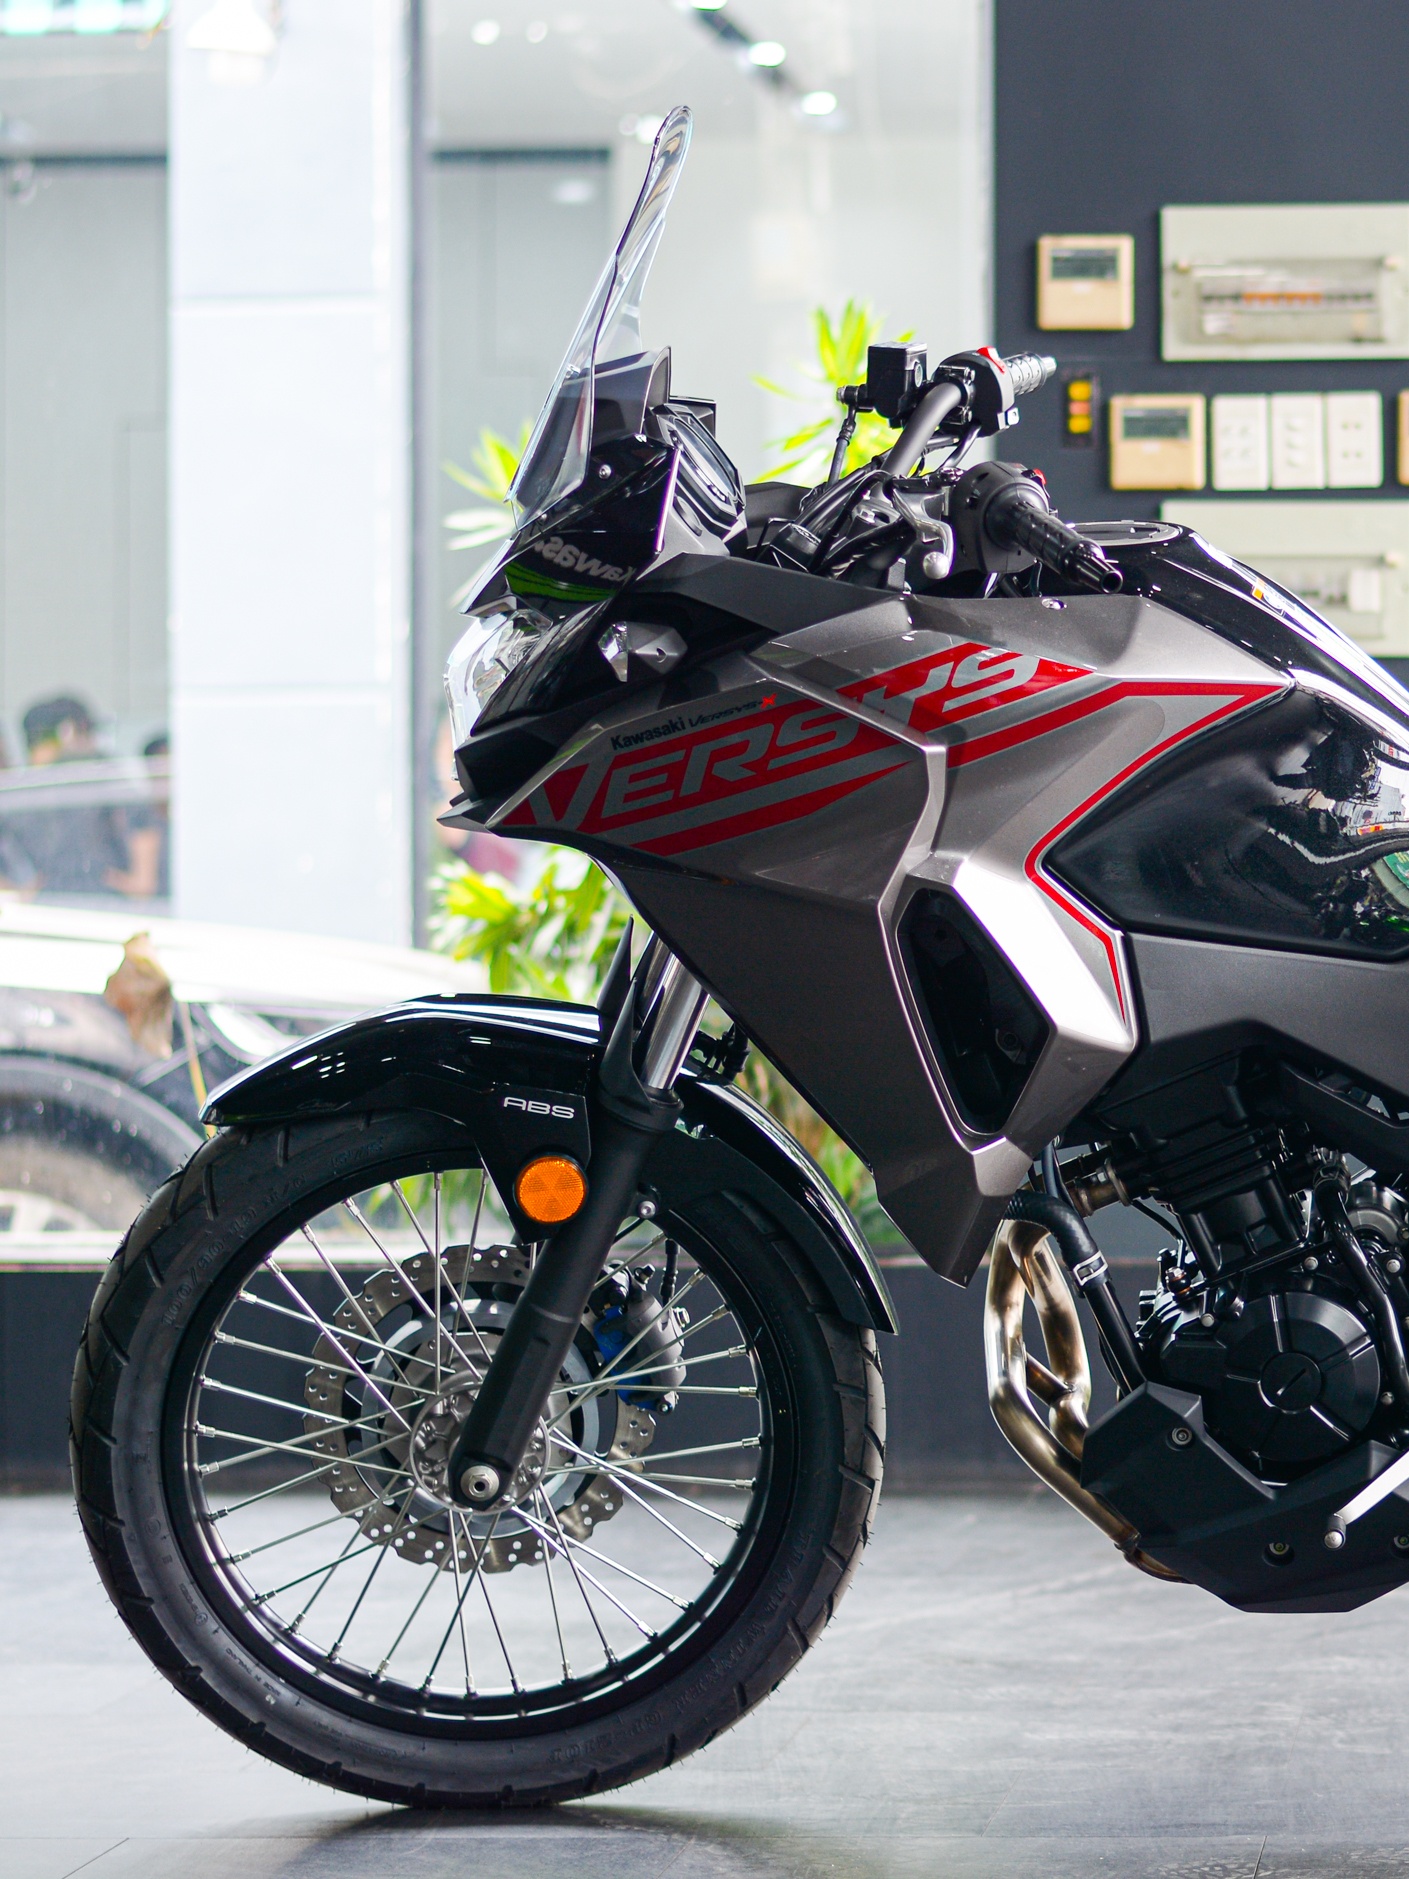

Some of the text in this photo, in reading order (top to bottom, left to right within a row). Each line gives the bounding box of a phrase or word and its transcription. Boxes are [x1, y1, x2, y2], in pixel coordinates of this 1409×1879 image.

[530, 651, 1040, 832] VERSYS
[610, 716, 686, 750] Kawasaki
[503, 1096, 575, 1119] ABS
